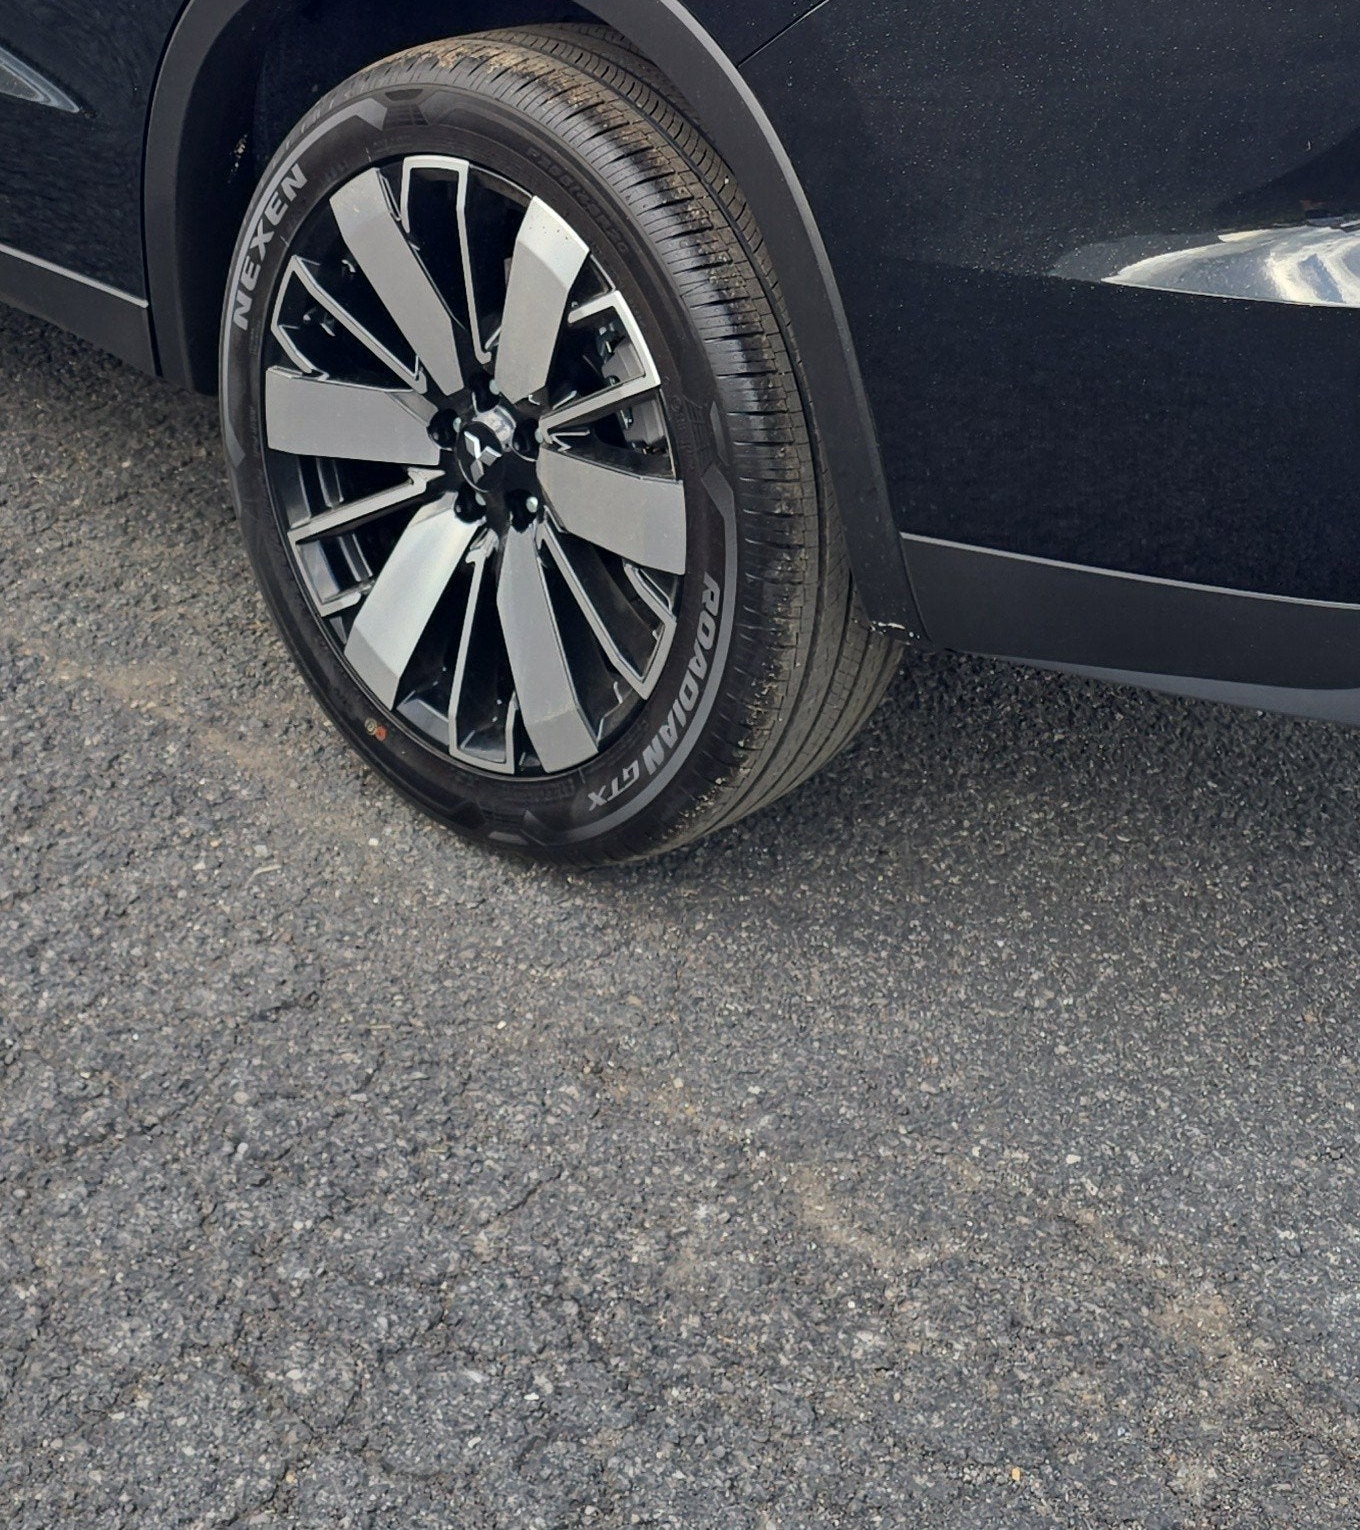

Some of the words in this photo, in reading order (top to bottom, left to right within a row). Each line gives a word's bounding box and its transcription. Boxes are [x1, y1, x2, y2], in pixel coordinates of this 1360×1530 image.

[233, 163, 308, 331] NEXEN
[643, 571, 721, 776] ROADIAN
[588, 760, 640, 812] GTX
